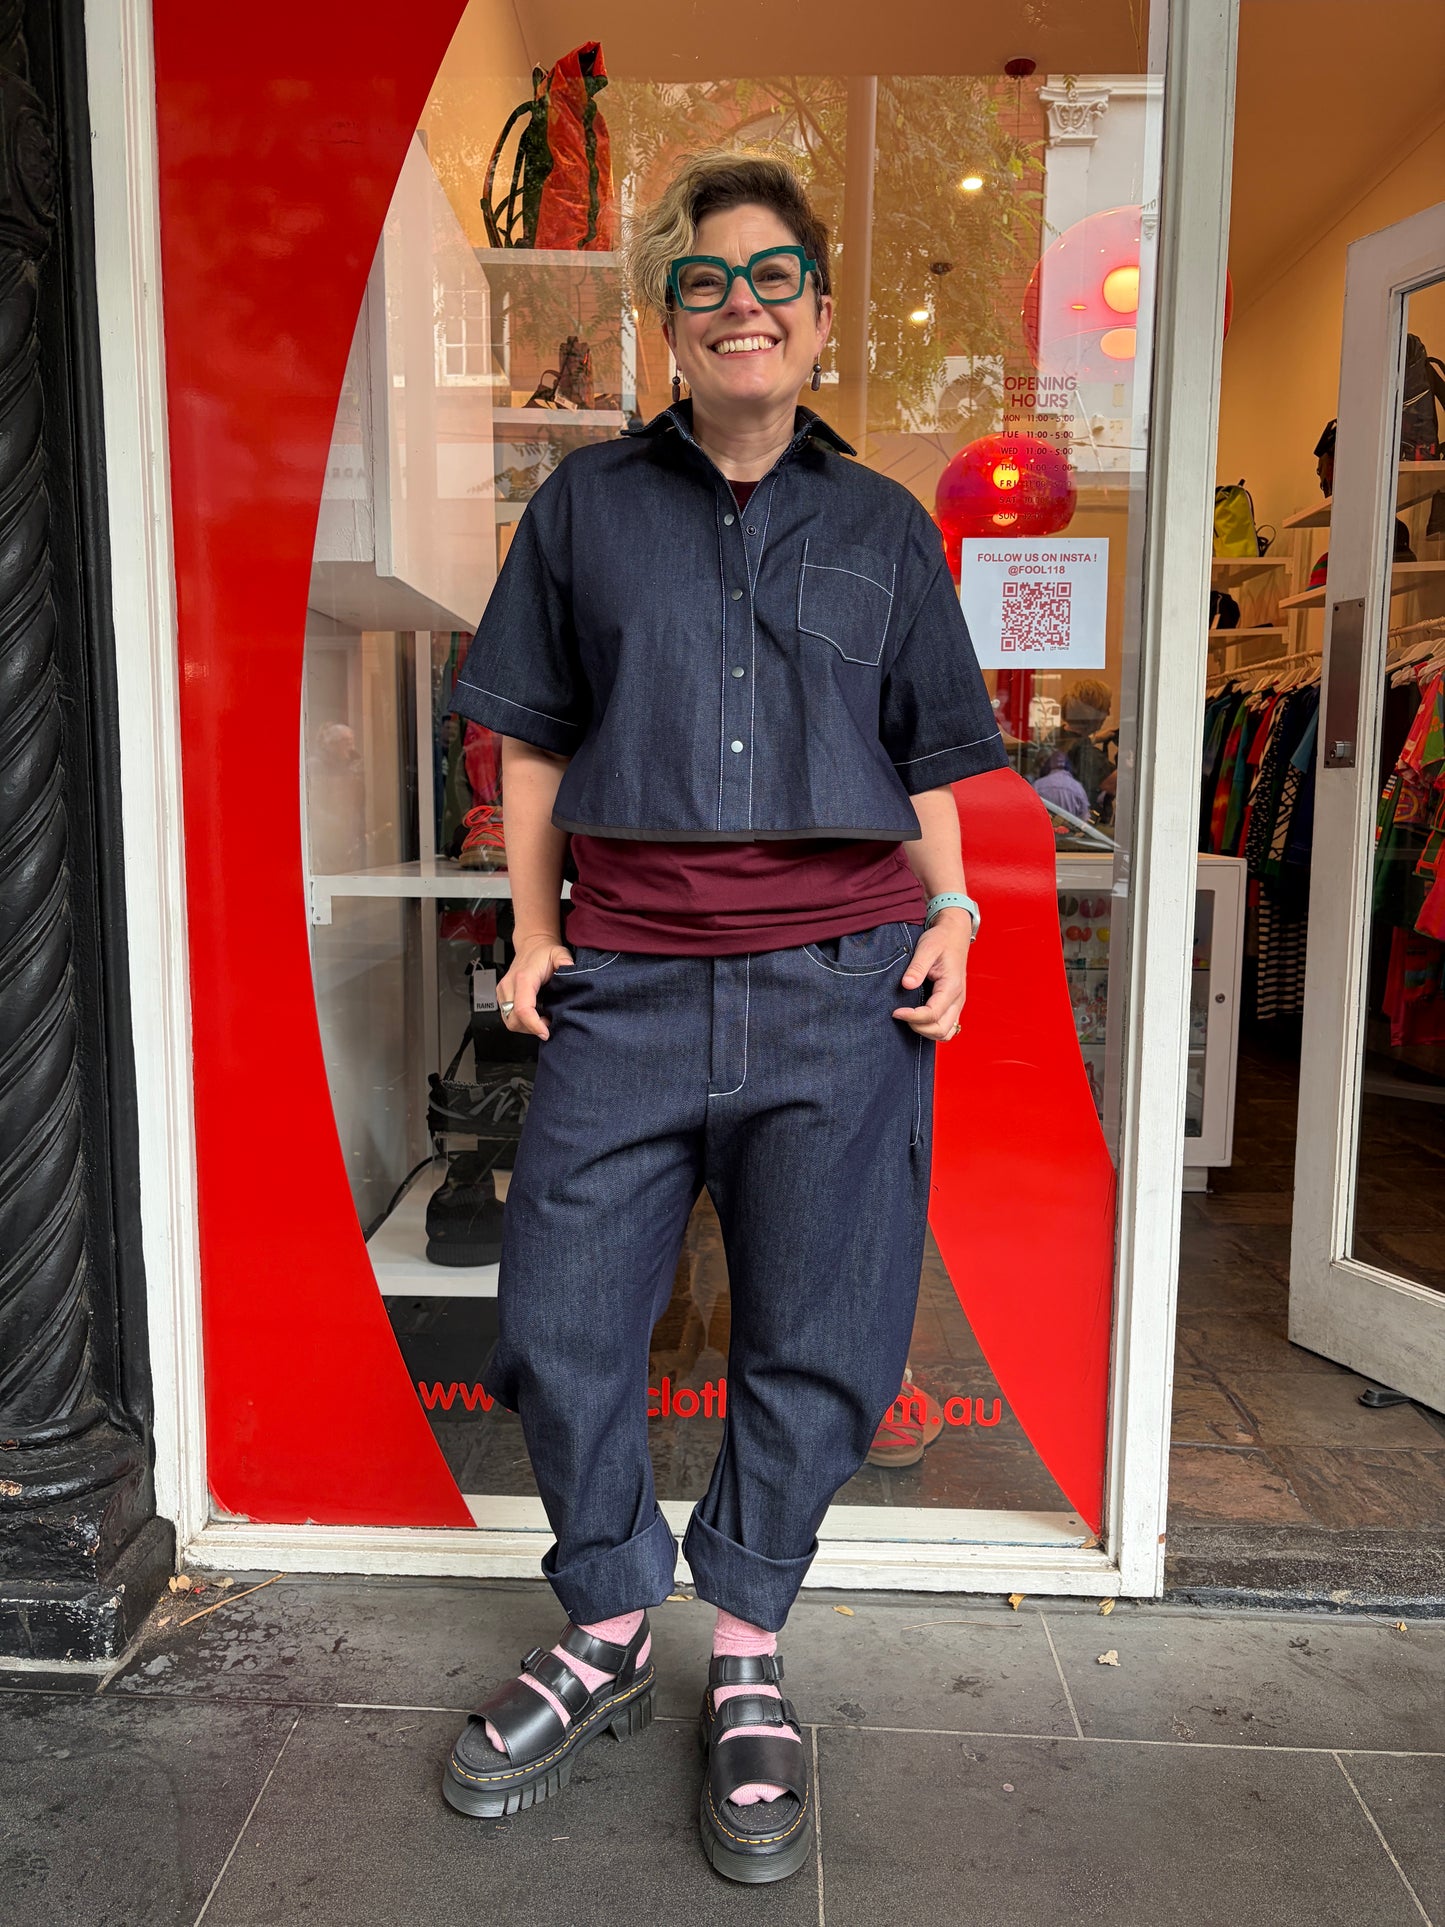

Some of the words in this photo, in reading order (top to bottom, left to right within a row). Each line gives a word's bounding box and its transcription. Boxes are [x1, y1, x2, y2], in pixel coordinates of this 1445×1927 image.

[1004, 376, 1077, 391] OPENING
[1011, 393, 1069, 408] HOURS
[1003, 414, 1020, 422] MON
[1027, 414, 1048, 422] 11:00
[1056, 414, 1075, 422] 5:00
[1055, 431, 1074, 439] 5:00
[1001, 447, 1018, 455] WED
[1026, 447, 1047, 455] 11:00
[1055, 447, 1073, 456] 5:00
[1025, 464, 1047, 472] 11:00
[1054, 464, 1073, 472] 5:00
[977, 553, 1022, 562] FOLLOW
[1024, 553, 1039, 562] US
[1041, 553, 1057, 562] ON
[1060, 553, 1091, 562] INSTA
[1008, 565, 1066, 576] @FOOL118
